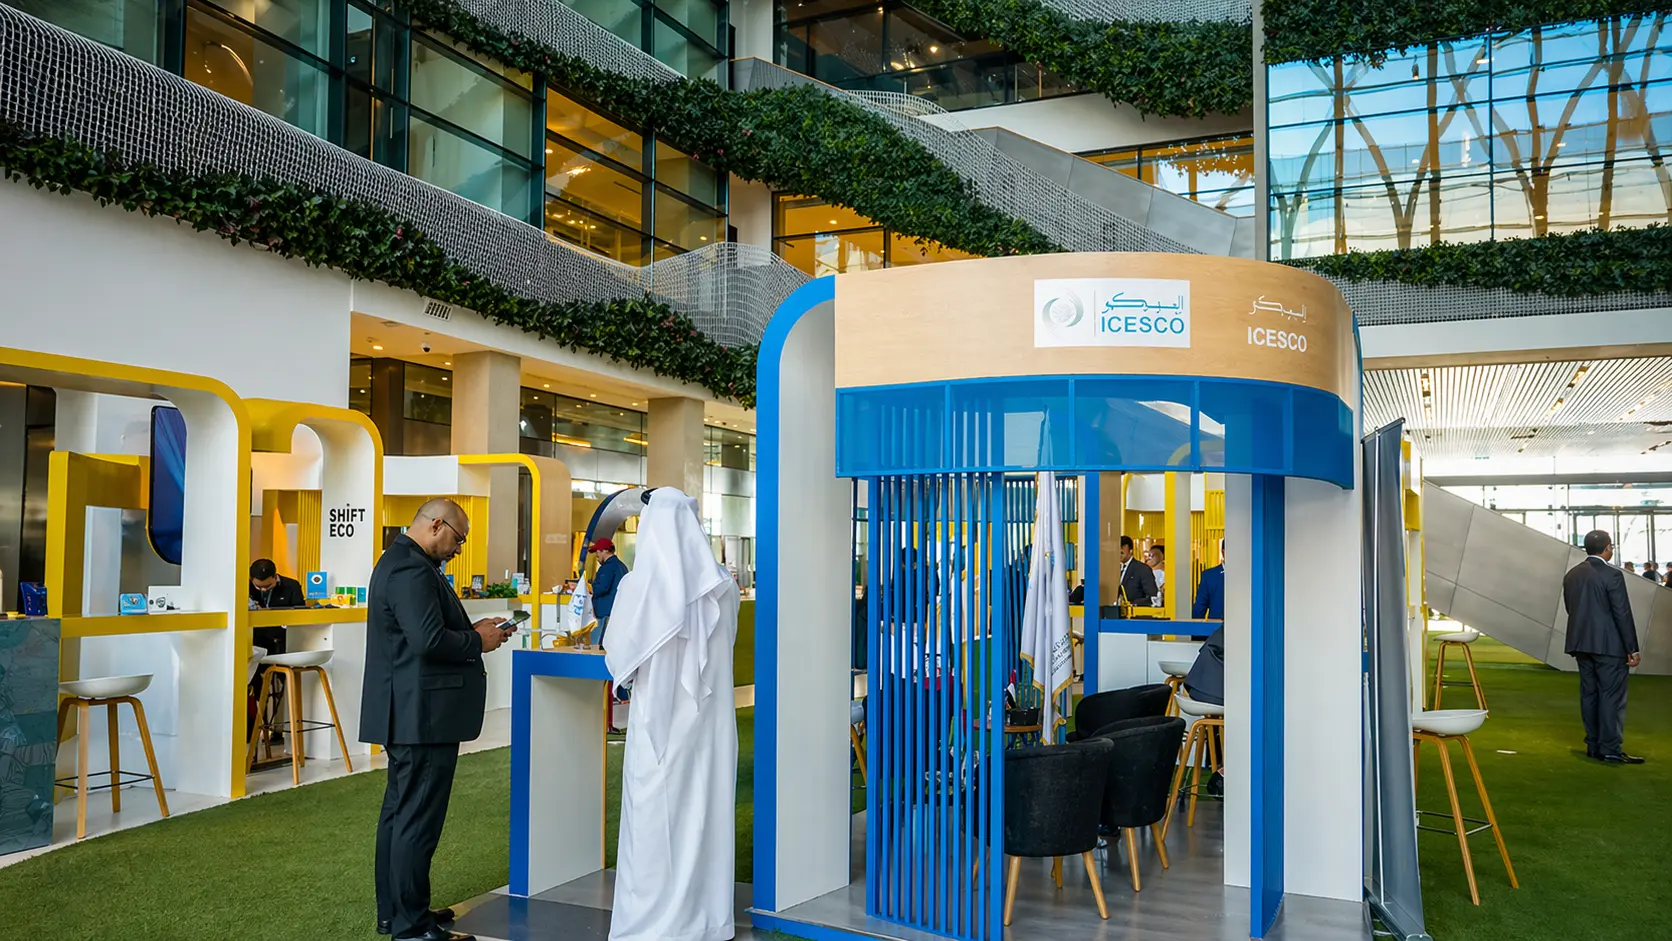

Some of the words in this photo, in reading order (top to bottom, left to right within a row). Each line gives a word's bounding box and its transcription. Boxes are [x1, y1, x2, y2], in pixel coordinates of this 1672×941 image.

[1101, 316, 1185, 334] ICESCO
[1248, 326, 1307, 353] ICESCO
[329, 523, 355, 538] ECO
